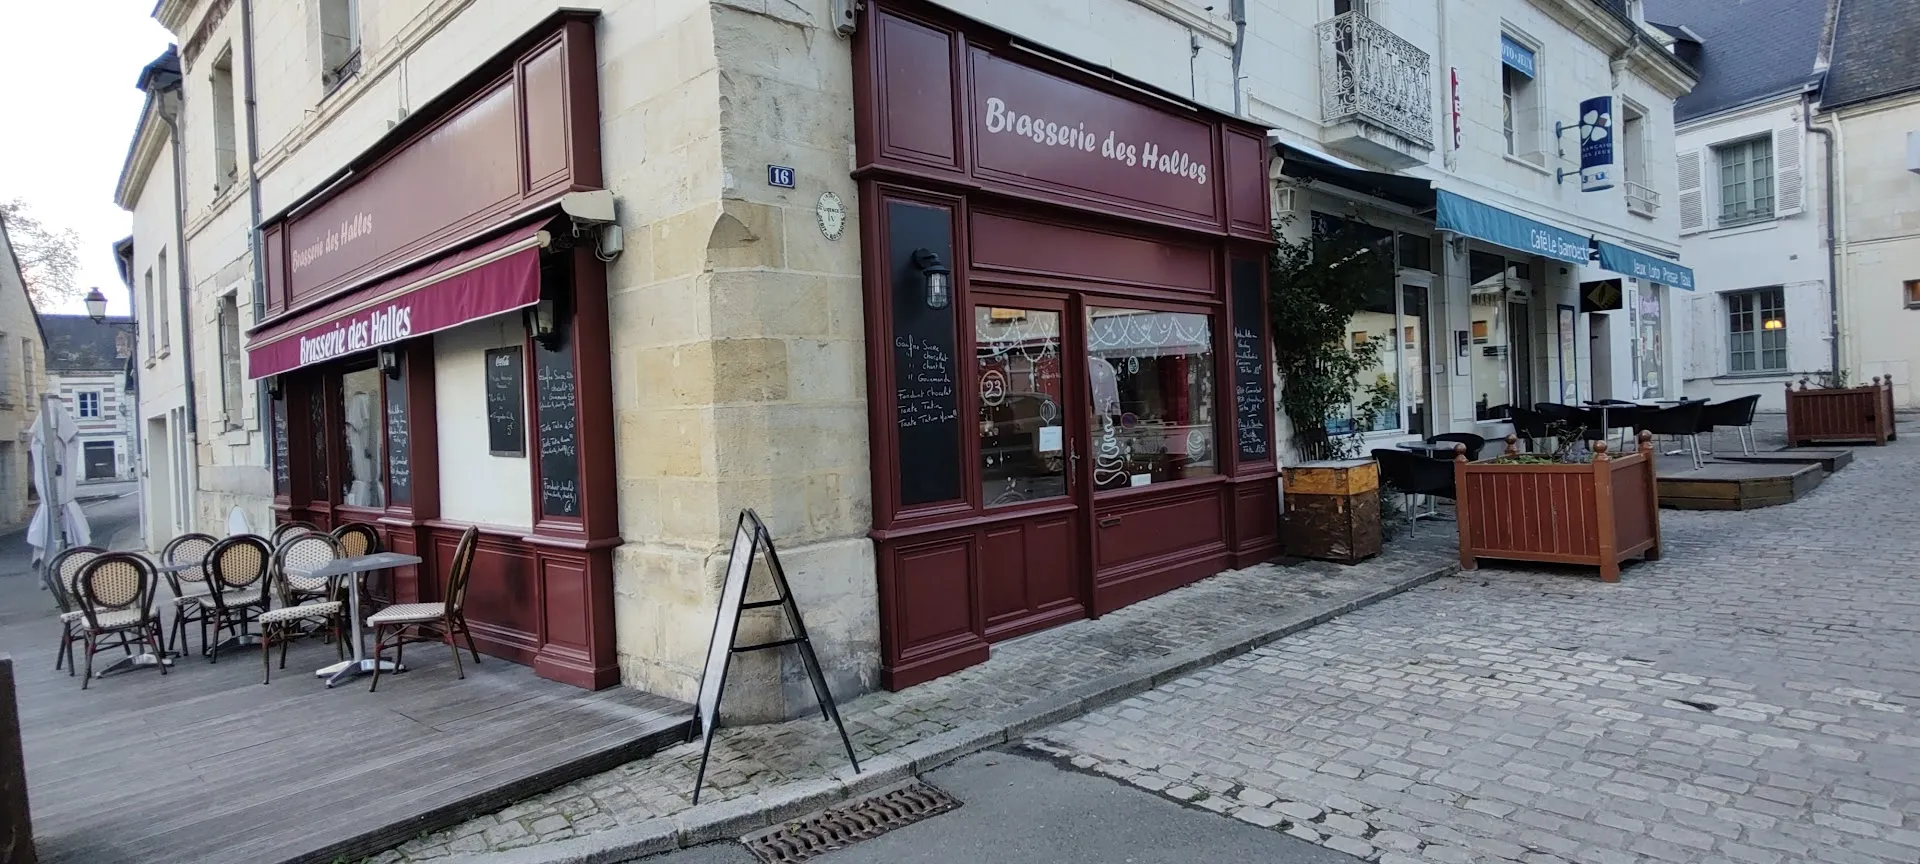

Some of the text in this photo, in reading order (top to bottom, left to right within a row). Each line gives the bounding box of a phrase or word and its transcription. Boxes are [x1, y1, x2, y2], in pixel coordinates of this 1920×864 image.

[1517, 52, 1533, 71] JEUX
[985, 96, 1208, 185] Brasserie des Halles
[775, 168, 789, 184] 16
[292, 211, 372, 273] Brasserie des Halles
[1531, 228, 1548, 251] Café
[1548, 233, 1557, 253] Le
[299, 304, 411, 365] Brasserie des Halles
[984, 379, 1002, 398] 23
